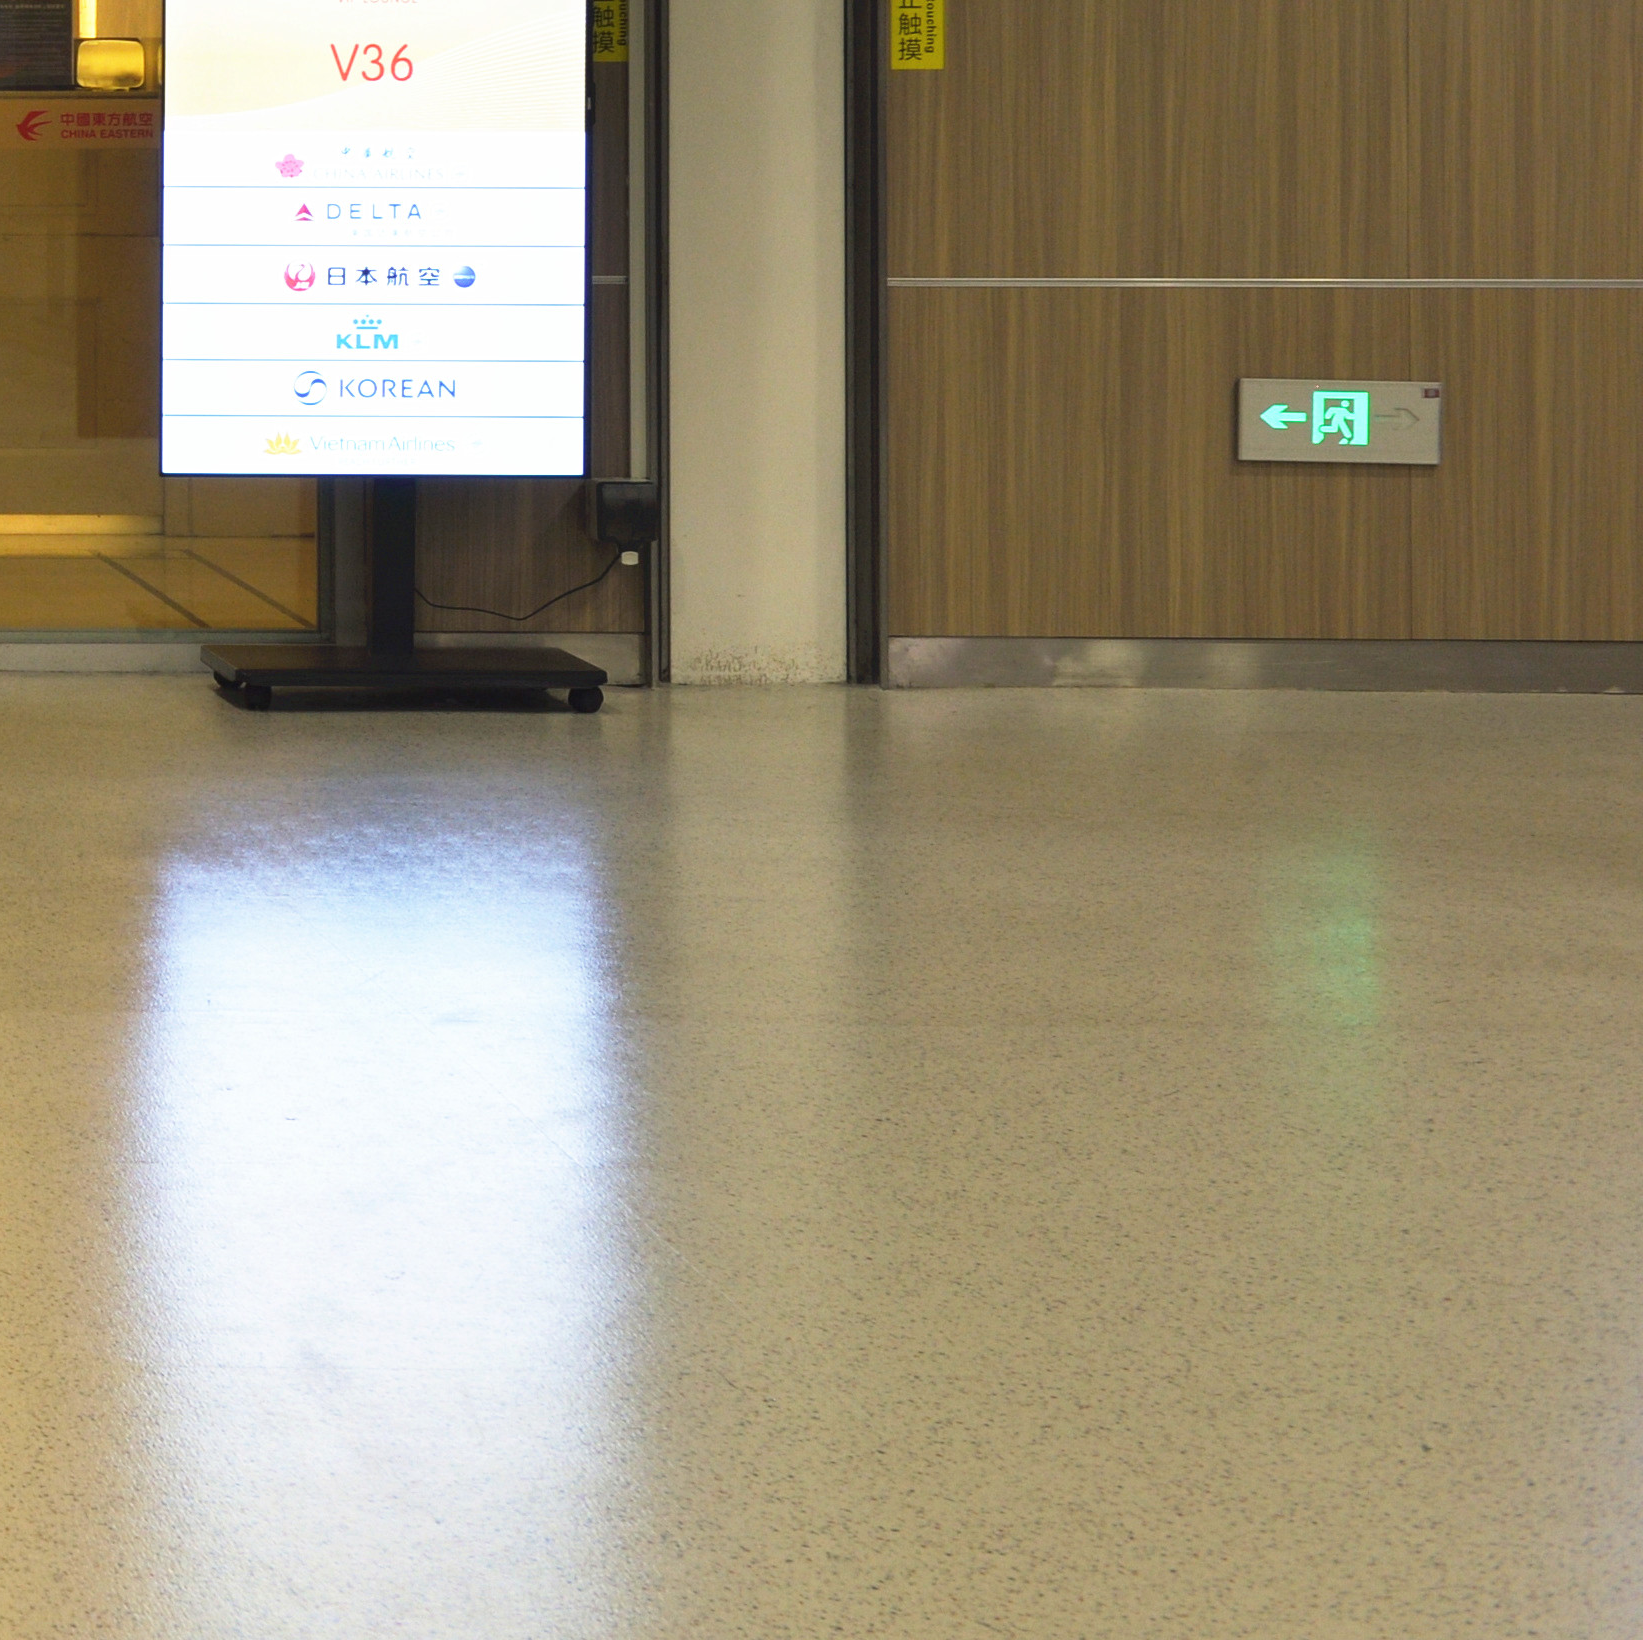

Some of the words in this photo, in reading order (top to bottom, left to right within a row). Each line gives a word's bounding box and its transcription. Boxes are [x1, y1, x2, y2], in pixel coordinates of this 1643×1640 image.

[329, 42, 414, 83] V36
[60, 111, 154, 127] 中國東方航空
[60, 128, 96, 140] CHINA
[99, 128, 154, 140] EASTERN
[326, 202, 423, 221] DELTA
[327, 265, 441, 287] 日本航空
[335, 333, 399, 350] KLM
[339, 378, 456, 399] KOREAN
[310, 434, 386, 453] Vietnam
[387, 434, 456, 453] Airlines
